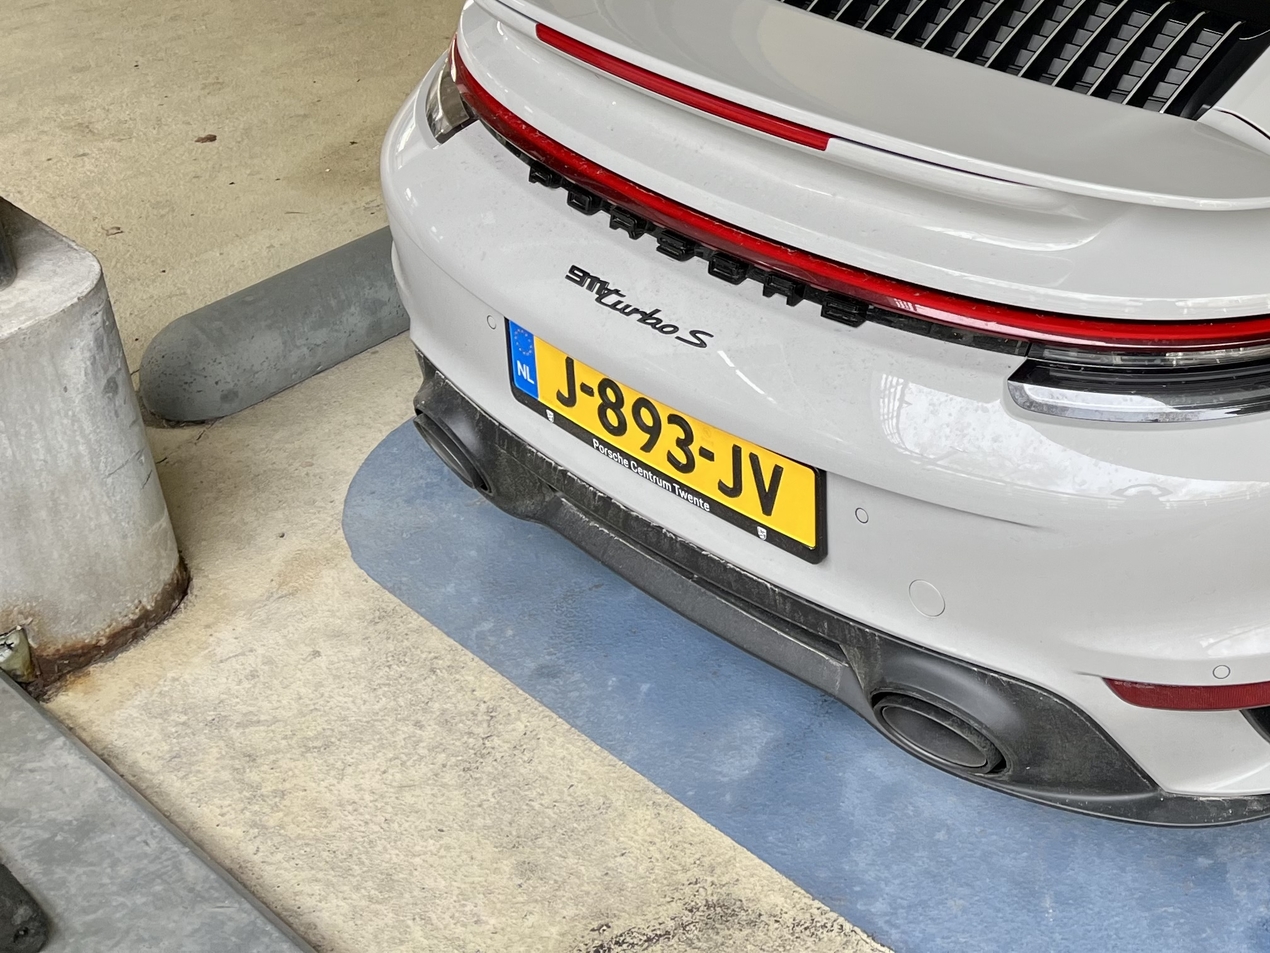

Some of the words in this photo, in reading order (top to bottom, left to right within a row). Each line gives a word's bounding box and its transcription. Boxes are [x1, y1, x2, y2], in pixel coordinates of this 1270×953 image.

[595, 288, 680, 335] turbo
[674, 329, 715, 349] S
[516, 360, 535, 385] NL
[556, 356, 784, 517] J-893-JV
[592, 438, 629, 468] Porsche
[630, 460, 672, 492] Centrum
[672, 483, 711, 512] Twente
